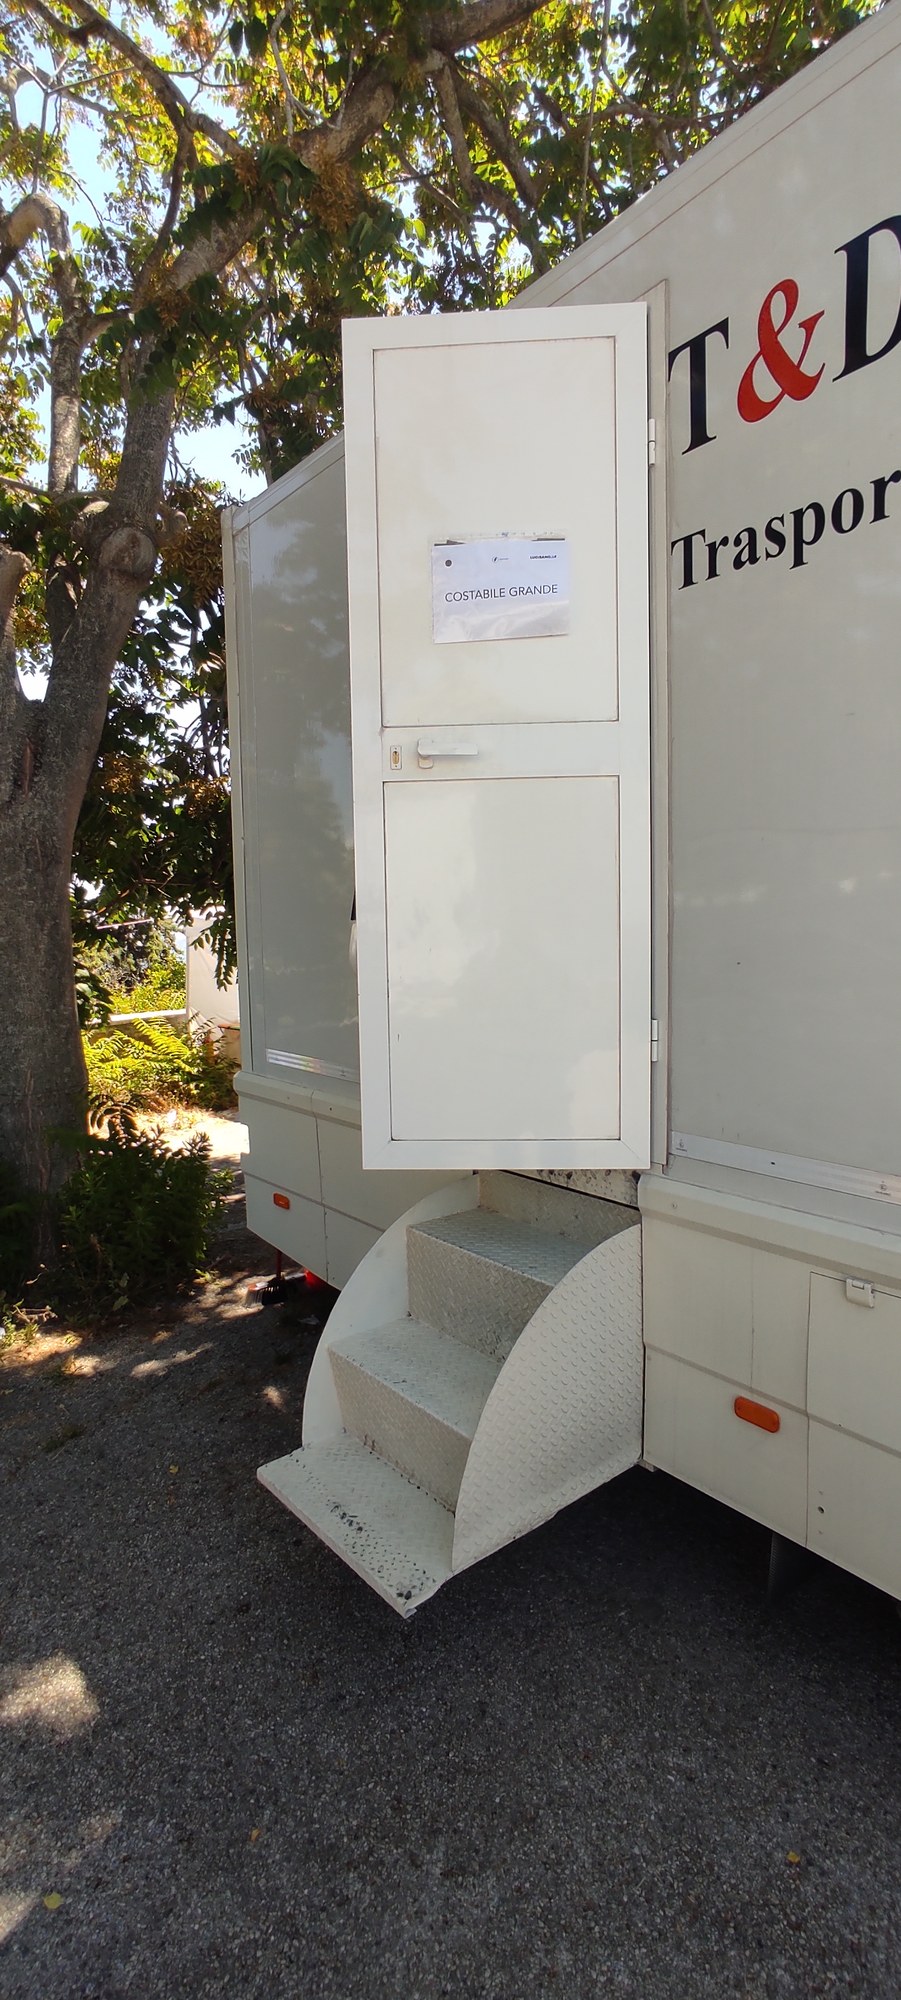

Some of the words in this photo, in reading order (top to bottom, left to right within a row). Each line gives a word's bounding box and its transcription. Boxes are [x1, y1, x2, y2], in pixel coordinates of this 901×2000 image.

[671, 469, 901, 591] Traspor
[444, 587, 506, 603] COSTABILE
[508, 584, 558, 597] GRANDE
